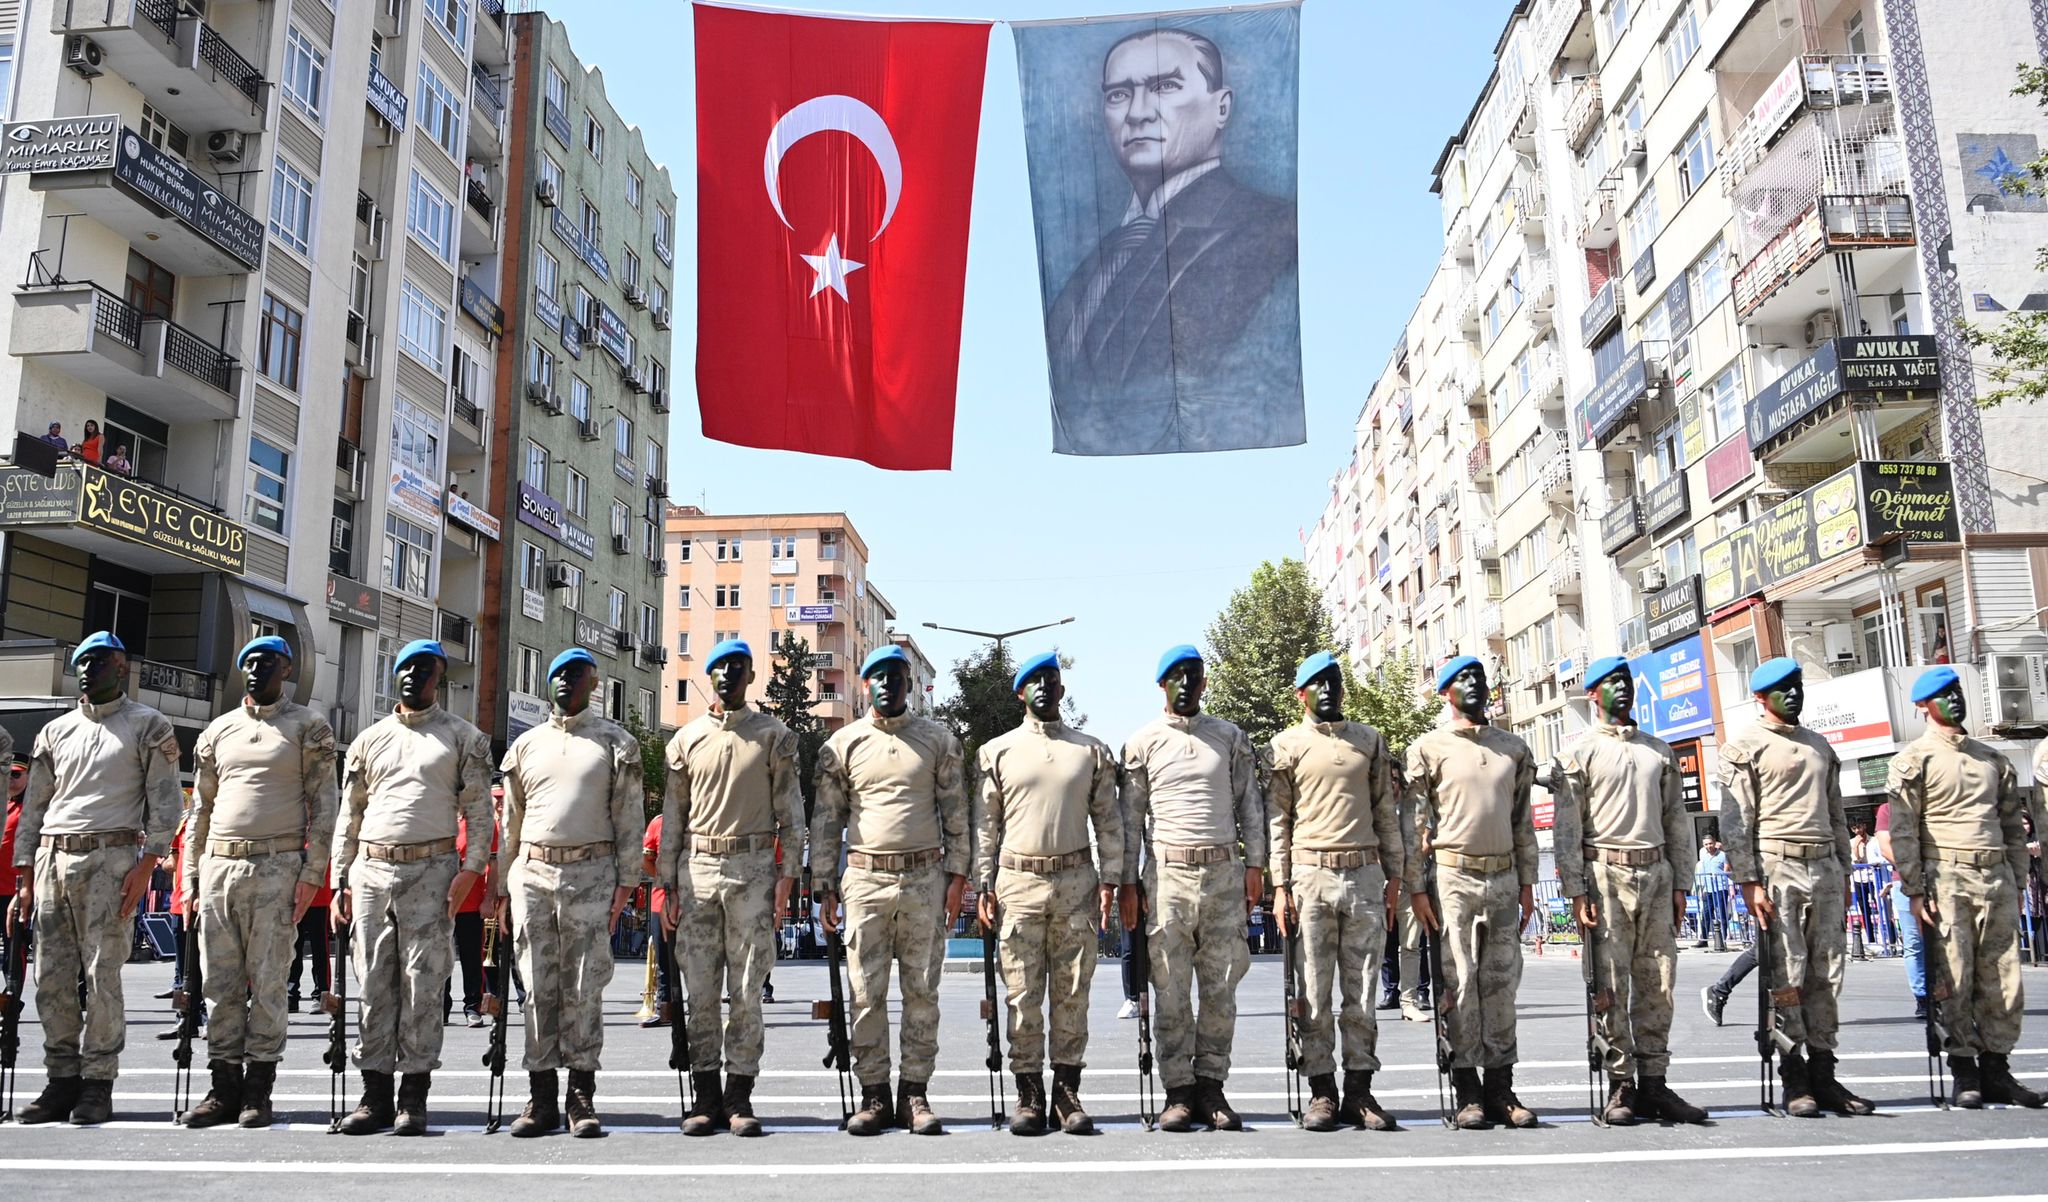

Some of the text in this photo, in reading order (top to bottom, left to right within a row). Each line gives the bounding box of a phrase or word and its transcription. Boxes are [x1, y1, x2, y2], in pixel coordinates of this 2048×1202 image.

[373, 71, 406, 111] AVUKAT
[1759, 65, 1796, 122] AVUKAT
[47, 121, 113, 138] MAVLU
[6, 154, 110, 171] Yunus Emre KAÇAMAZ
[136, 172, 155, 194] Halil
[140, 157, 195, 201] HUKUK BÜROSU
[225, 205, 262, 238] MAVLU
[538, 292, 560, 316] AVUKAT
[602, 310, 626, 339] AVUKAT
[1856, 340, 1920, 358] AVUKAT
[1780, 357, 1816, 396] AVUKAT
[1847, 359, 1937, 378] MUSTAFA YAĞIZ
[1768, 371, 1838, 432] MUSTAFA YAĞIZ
[1879, 464, 1937, 476] 0553 737 98 68
[1654, 478, 1680, 509] AVUKAT
[1870, 488, 1951, 513] Dövmeci
[119, 488, 243, 552] ESTE CLUB
[522, 493, 561, 528] SONGÜL
[1883, 504, 1951, 529] Ahmet
[568, 526, 593, 549] AVUKAT
[1757, 502, 1808, 556] Dövmeci
[1922, 531, 1932, 539] 98
[1934, 531, 1944, 539] 68
[153, 530, 241, 567] GÜZELLİK & SAĞLIKLI YAŞAM
[1761, 526, 1809, 577] Ahmet
[1661, 585, 1690, 613] AVUKAT
[517, 699, 540, 715] YILDIRIM
